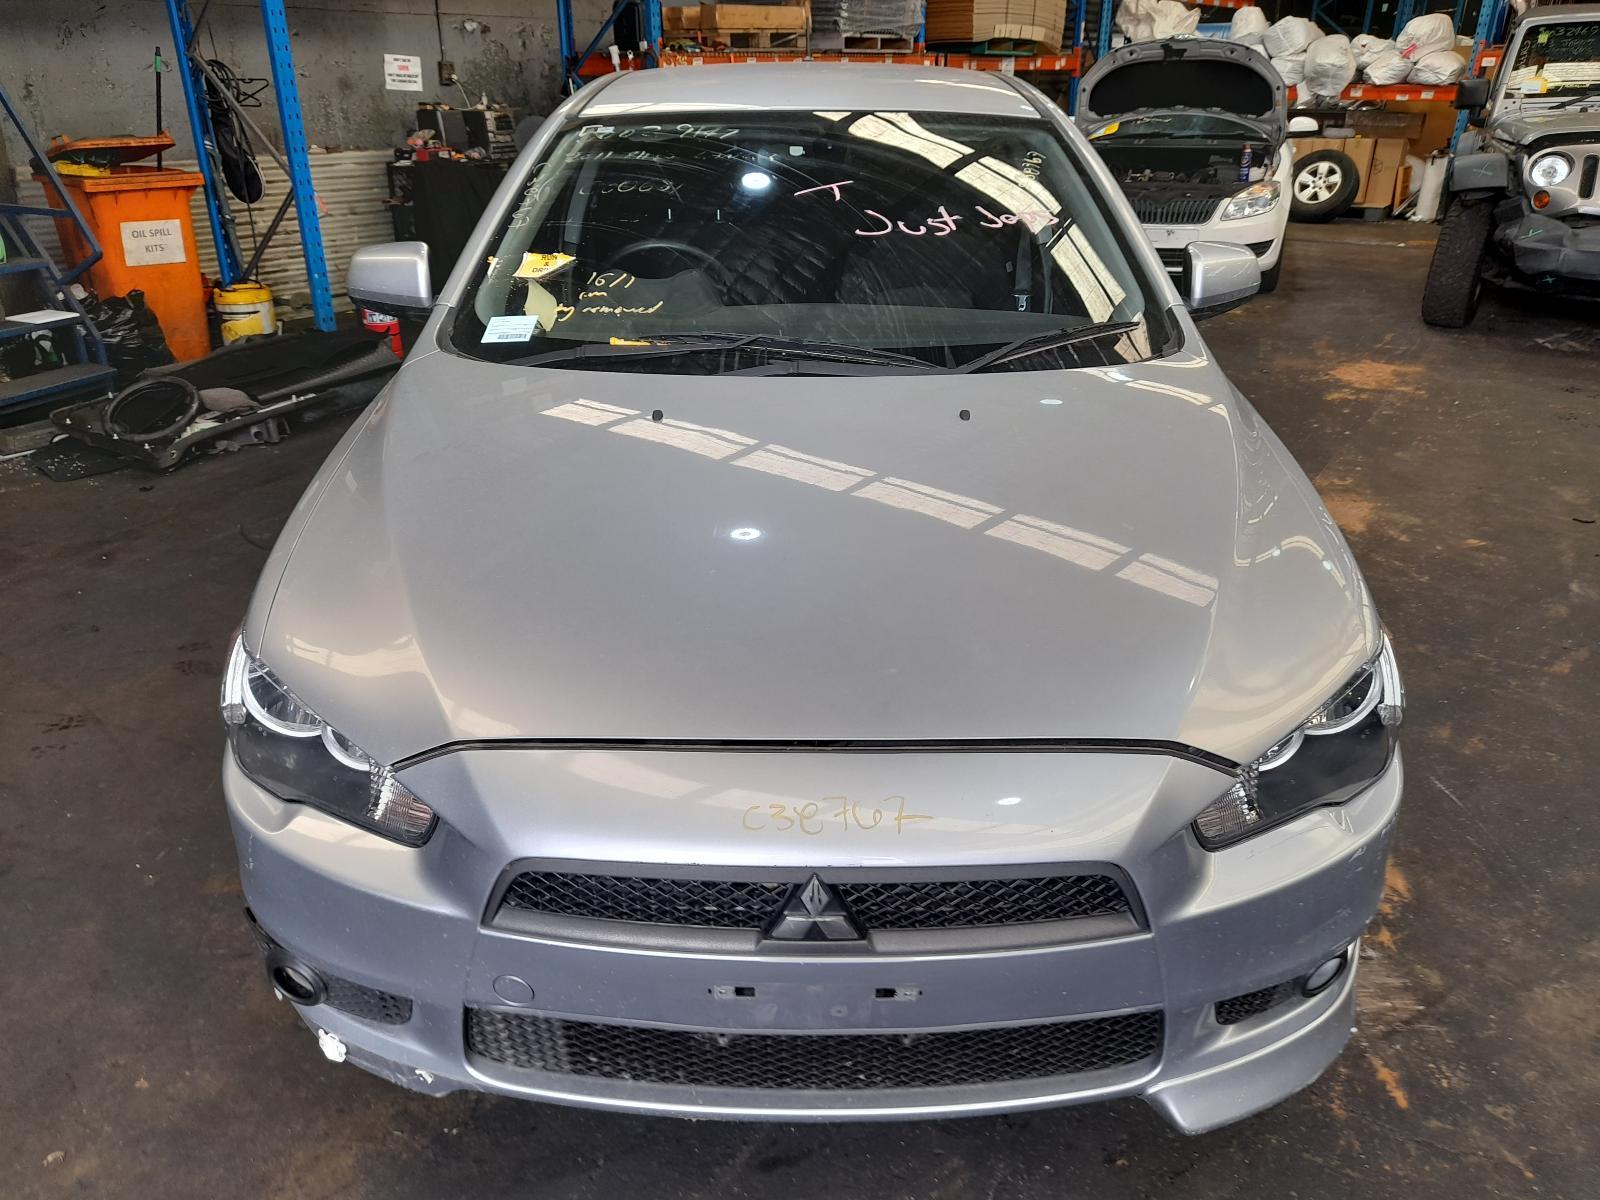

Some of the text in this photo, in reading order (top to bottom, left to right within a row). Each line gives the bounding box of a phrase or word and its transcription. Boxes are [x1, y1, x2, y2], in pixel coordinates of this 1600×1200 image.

[855, 205, 963, 236] Just
[131, 227, 172, 239] OIL SPILL
[144, 243, 165, 253] KITS
